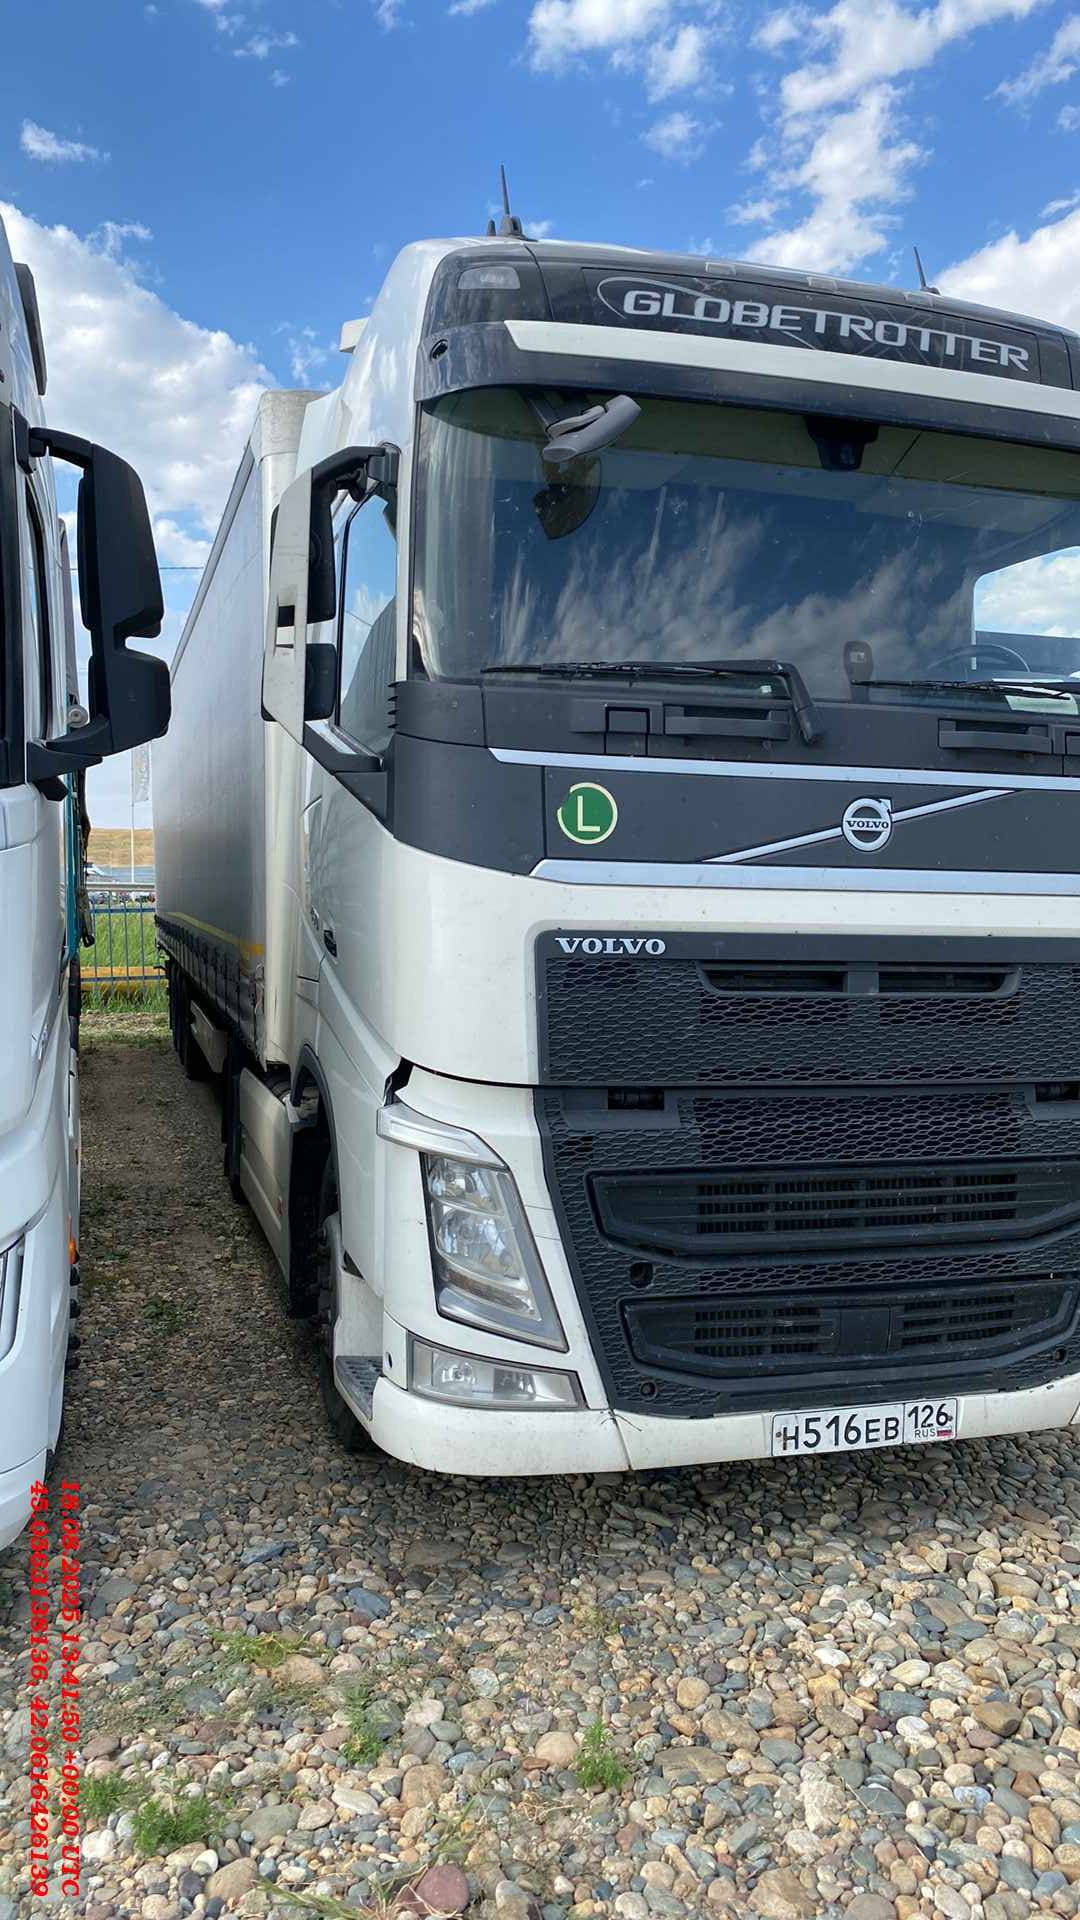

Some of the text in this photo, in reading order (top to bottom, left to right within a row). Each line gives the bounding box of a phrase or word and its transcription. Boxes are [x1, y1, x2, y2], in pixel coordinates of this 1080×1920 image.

[623, 290, 1029, 371] GLOBETROTTER
[577, 795, 601, 832] L
[846, 820, 889, 829] VOLVO
[555, 937, 666, 955] VOLVO
[908, 1403, 949, 1429] 126
[914, 1428, 936, 1439] RUS
